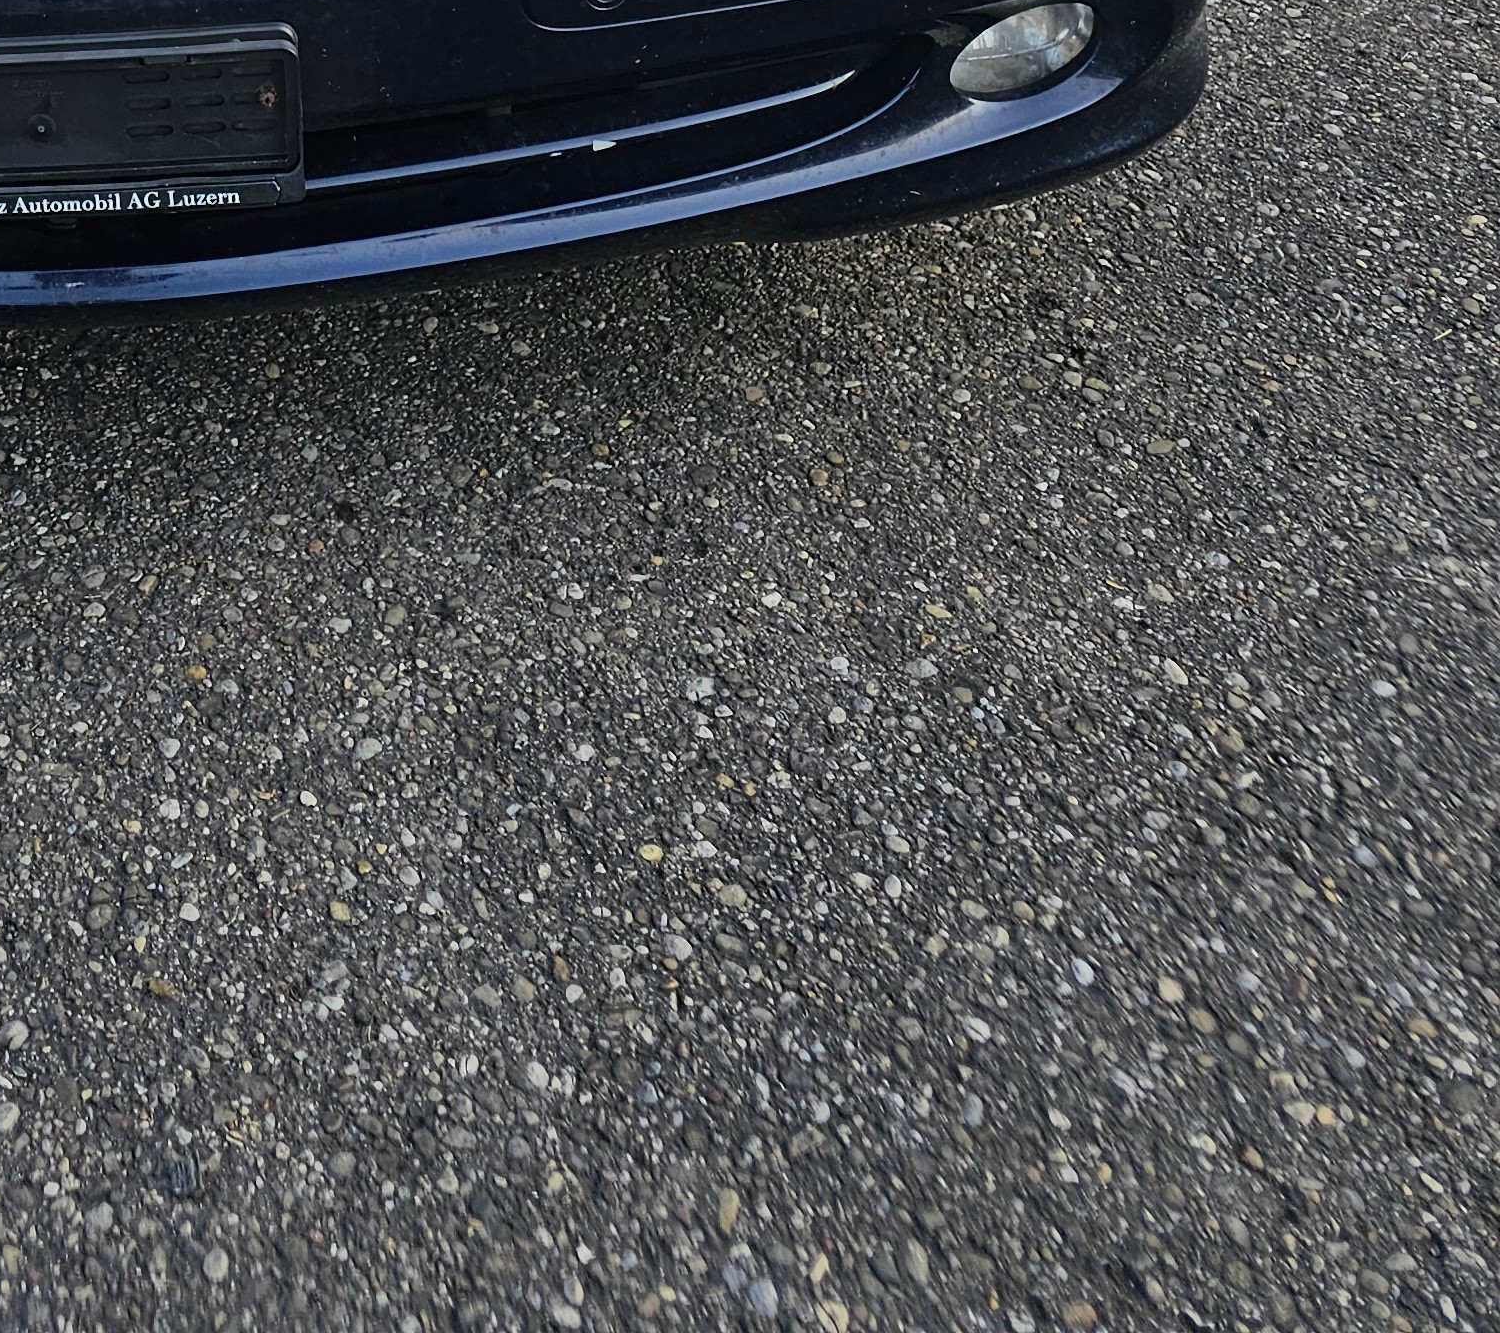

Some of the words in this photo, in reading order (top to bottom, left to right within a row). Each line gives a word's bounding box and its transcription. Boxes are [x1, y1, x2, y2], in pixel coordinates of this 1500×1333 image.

[12, 192, 122, 215] Automobil
[126, 191, 162, 210] AG
[167, 189, 241, 208] Luzern
